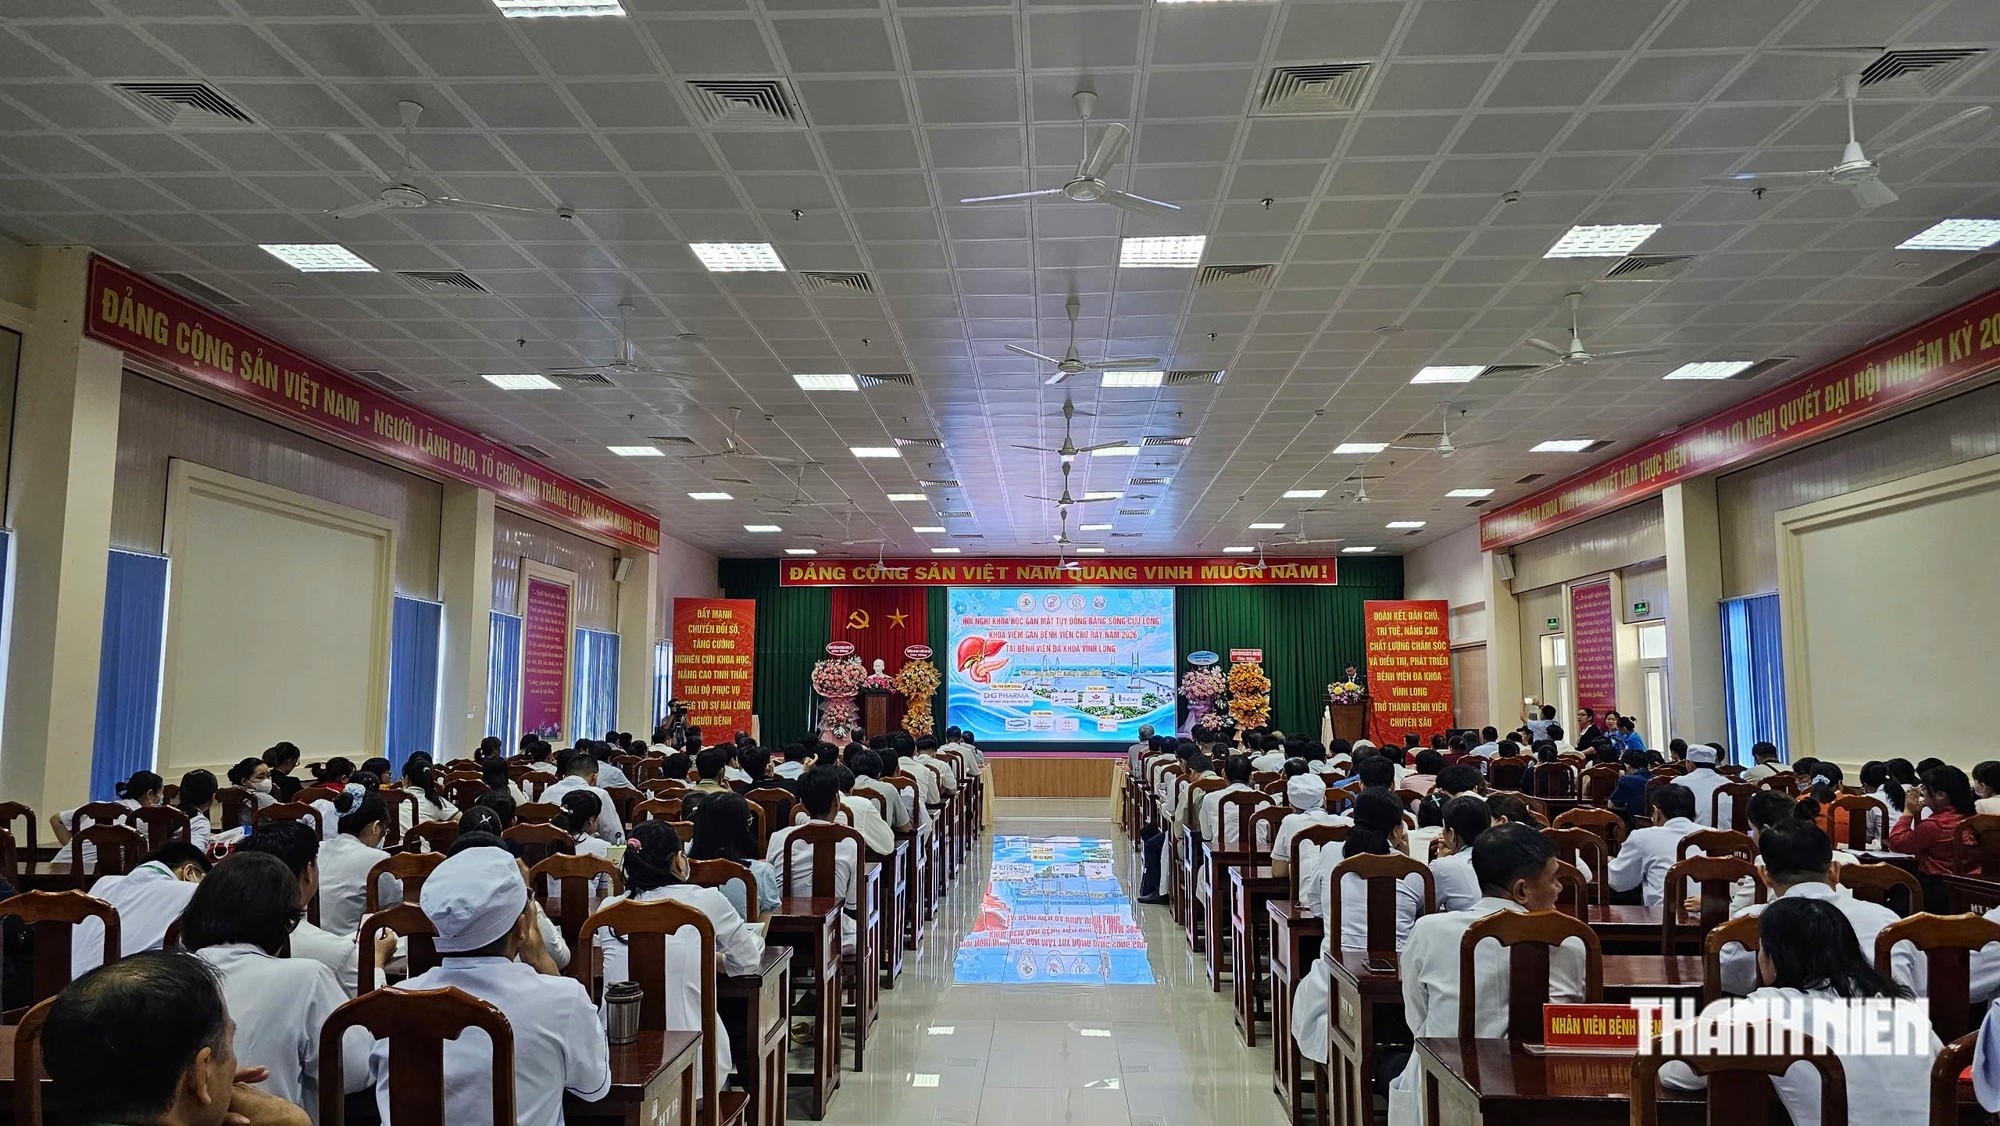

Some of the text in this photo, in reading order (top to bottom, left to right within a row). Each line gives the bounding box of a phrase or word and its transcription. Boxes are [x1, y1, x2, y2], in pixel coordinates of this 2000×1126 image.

[102, 286, 168, 346] ĐẢNG
[177, 323, 233, 373] CỘNG
[240, 347, 278, 393] SẢN
[284, 371, 319, 410] VIỆT
[324, 386, 359, 425] NAM
[373, 408, 415, 448] NGƯỜI
[419, 428, 450, 461] LÃNH
[453, 443, 478, 475] ĐẠO,
[481, 450, 495, 476] TỔ
[496, 462, 521, 489] CHỨC
[523, 473, 540, 497] MỌI
[542, 480, 567, 509] THẮNG
[569, 493, 580, 517] LỢI
[581, 495, 594, 519] CỦA
[597, 504, 613, 527] CÁCH
[614, 513, 632, 535] MẠNG
[633, 520, 645, 541] VIỆT
[646, 527, 658, 545] NAM
[1541, 498, 1558, 520] KHOA
[1620, 463, 1637, 489] TÂM
[1640, 453, 1661, 482] THỰC
[1664, 443, 1686, 473] HIỆN
[1726, 420, 1743, 448] LỢI
[1747, 408, 1776, 441] NGHỊ
[1780, 384, 1820, 431] QUYẾT
[1825, 379, 1849, 415] ĐẠI
[1855, 364, 1880, 402] HỘI
[1886, 340, 1943, 388] NHIỆM
[1950, 320, 1973, 362] KỲ
[790, 562, 846, 580] ĐẢNG
[852, 563, 908, 583] CỘNG
[915, 562, 956, 580] SẢN
[962, 563, 1008, 582] VIỆT
[1017, 565, 1061, 580] NAM
[1067, 565, 1137, 581] QUANG
[1144, 566, 1192, 579] VINH
[1201, 563, 1263, 580] MUÔN
[712, 610, 732, 621] MẠNH
[992, 617, 1009, 625] KHOA
[1025, 617, 1039, 625] GAN
[1142, 617, 1160, 625] LONG
[989, 631, 1006, 639] KHOA
[1025, 631, 1039, 639] GAN
[1425, 626, 1438, 635] CAO
[712, 638, 735, 649] CƯỜNG
[1063, 644, 1080, 652] KHOA
[1099, 645, 1116, 653] LONG
[1388, 641, 1410, 652] LƯỢNG
[1433, 640, 1447, 651] SÓC
[675, 653, 700, 664] NGHIÊN
[717, 655, 735, 664] KHOA
[698, 670, 712, 680] CAO
[713, 670, 729, 680] TINH
[1376, 670, 1442, 683] BỆNH VIỆN ĐA KHOA
[684, 684, 740, 696] THÁI ĐỘ PHỤC VỤ
[1392, 686, 1428, 696] VĨNH LONG
[1412, 701, 1430, 713] BỆNH
[1431, 701, 1447, 713] VIỆN
[714, 715, 732, 727] BỆNH
[1390, 716, 1432, 727] CHUYÊN SÂU
[1552, 1014, 1580, 1034] NHÂN
[1583, 1015, 1606, 1035] VIÊN
[1609, 1015, 1636, 1039] BỆNH
